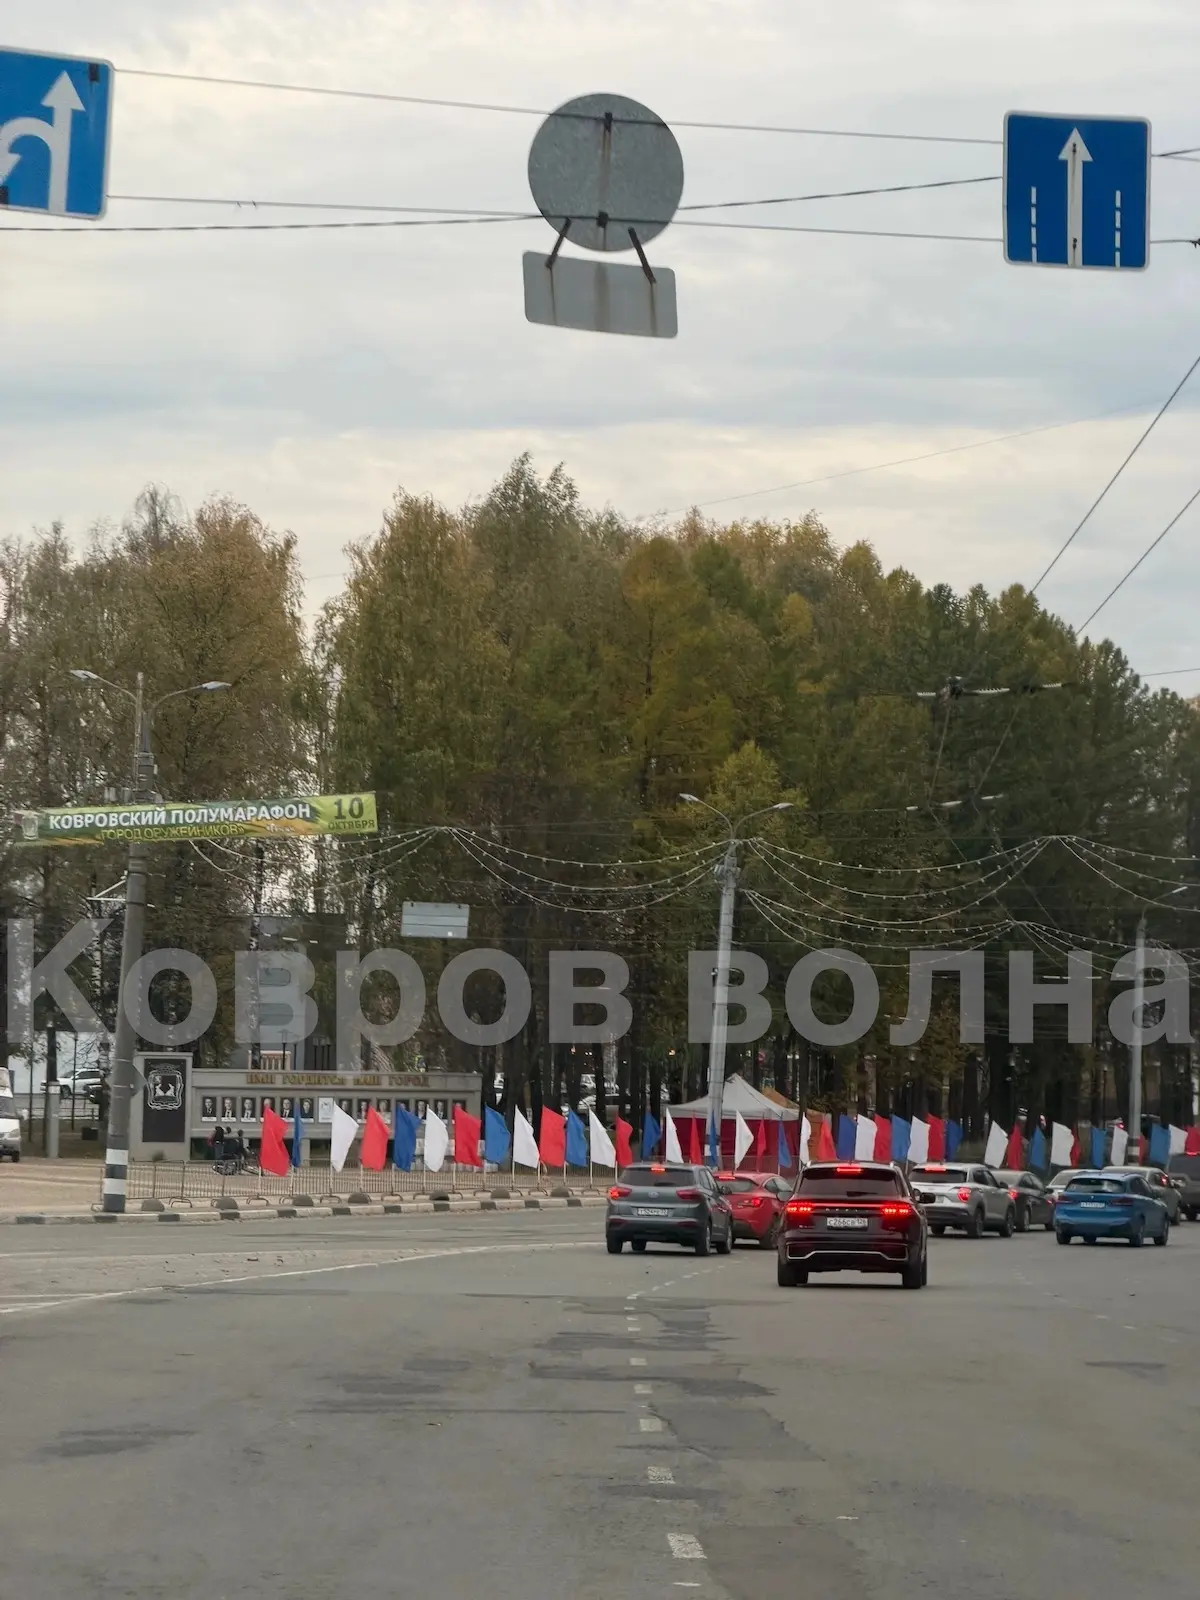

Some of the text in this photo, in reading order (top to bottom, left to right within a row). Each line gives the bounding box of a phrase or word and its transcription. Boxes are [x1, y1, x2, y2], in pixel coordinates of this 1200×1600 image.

[49, 803, 311, 830] КОВРОВСКИЙ ПОЛУМАРАФОН
[334, 796, 364, 820] 10
[328, 819, 375, 831] ОКТЯБРЯ
[388, 1075, 430, 1088] ГОРОД
